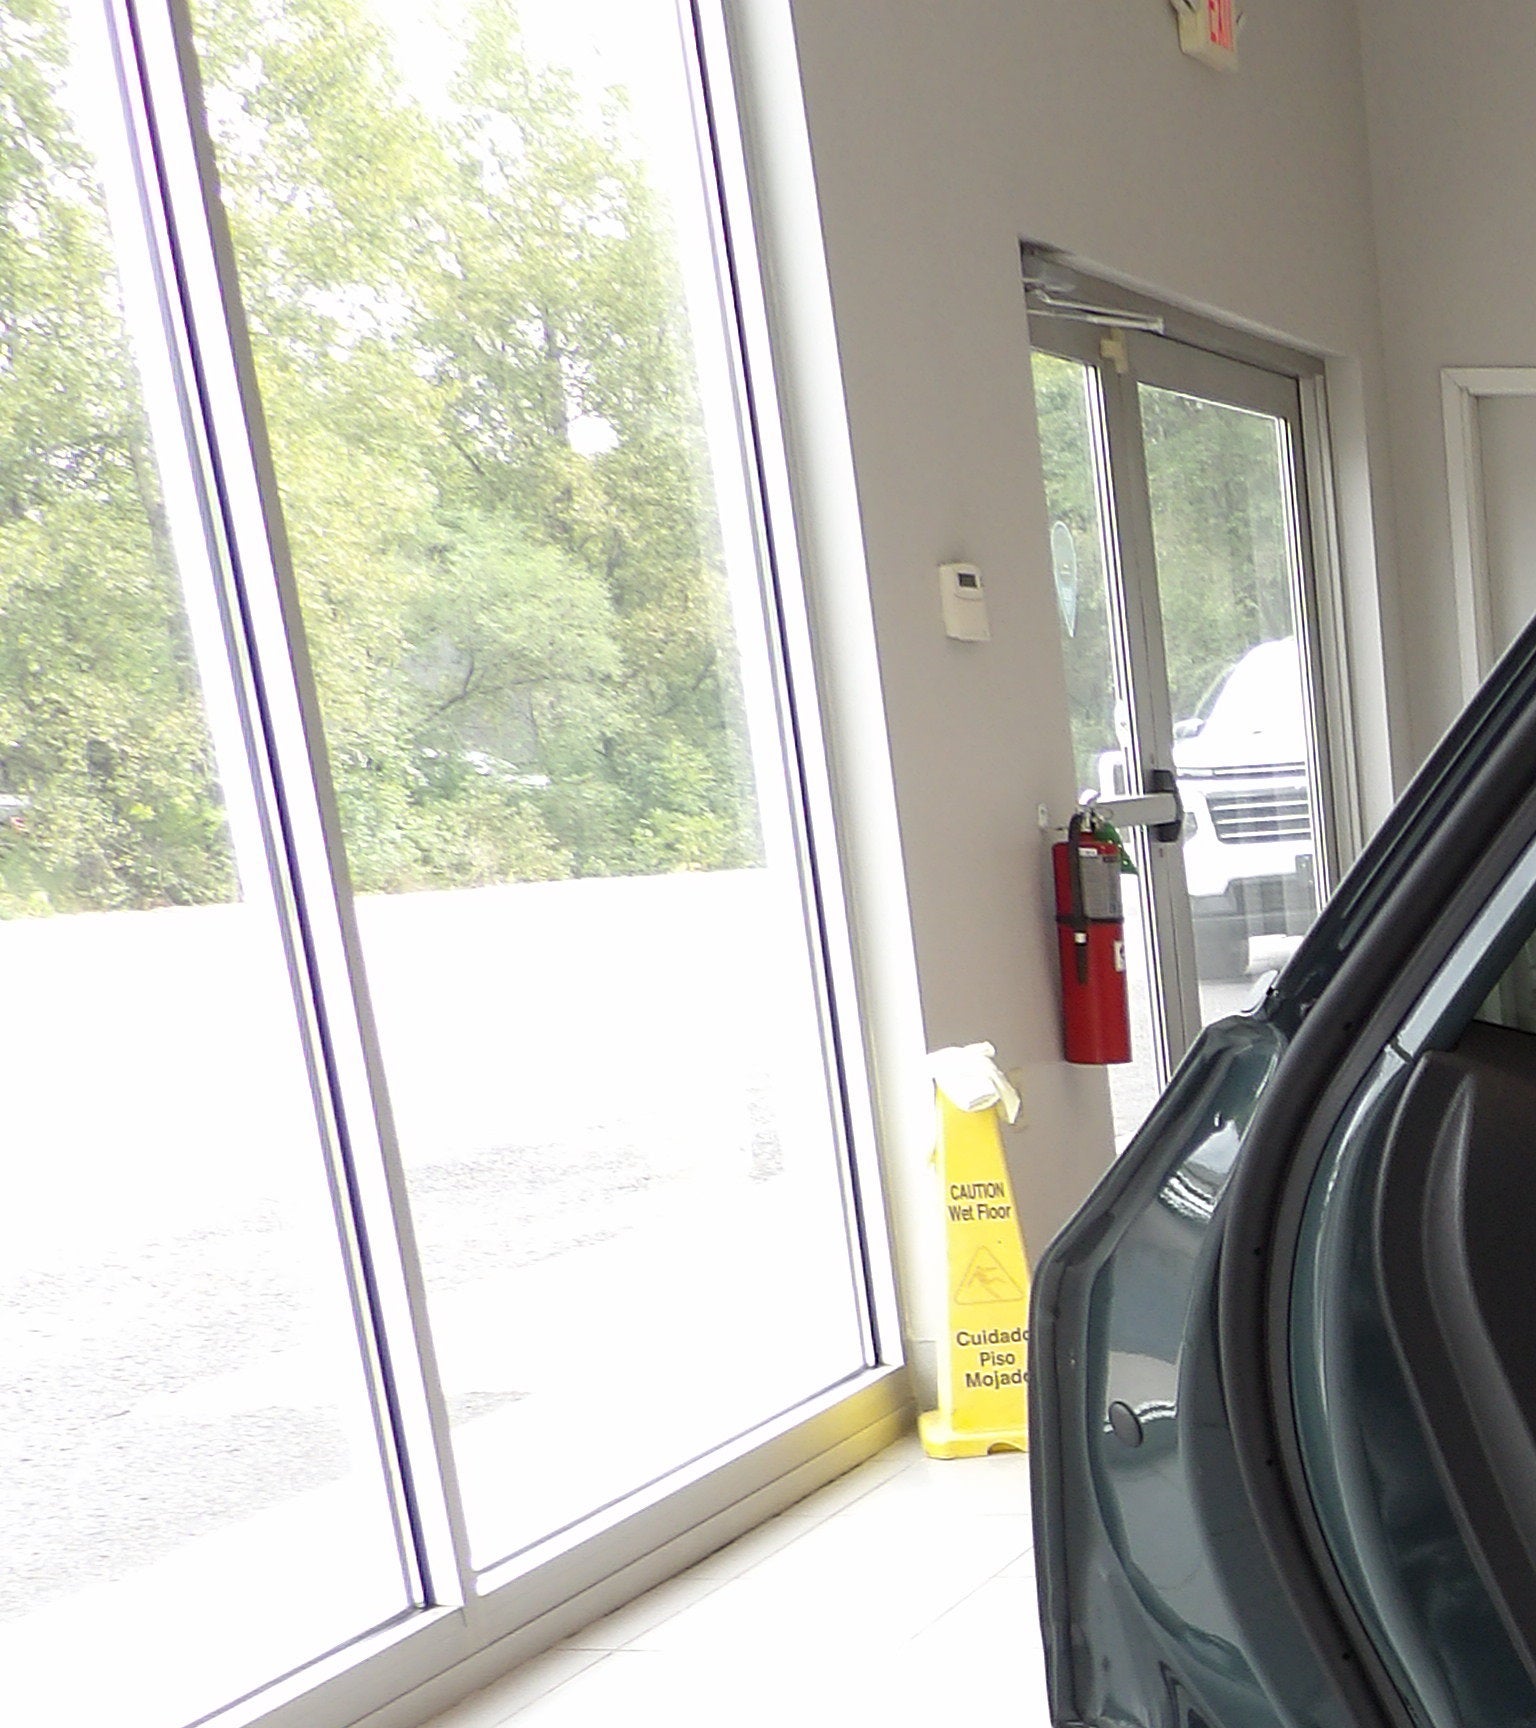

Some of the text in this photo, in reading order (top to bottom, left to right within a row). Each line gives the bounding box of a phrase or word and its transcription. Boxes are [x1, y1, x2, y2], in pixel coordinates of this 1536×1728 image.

[950, 1182, 1006, 1200] CAUTION
[948, 1203, 1011, 1222] Wet Floor
[979, 1351, 1016, 1367] Piso
